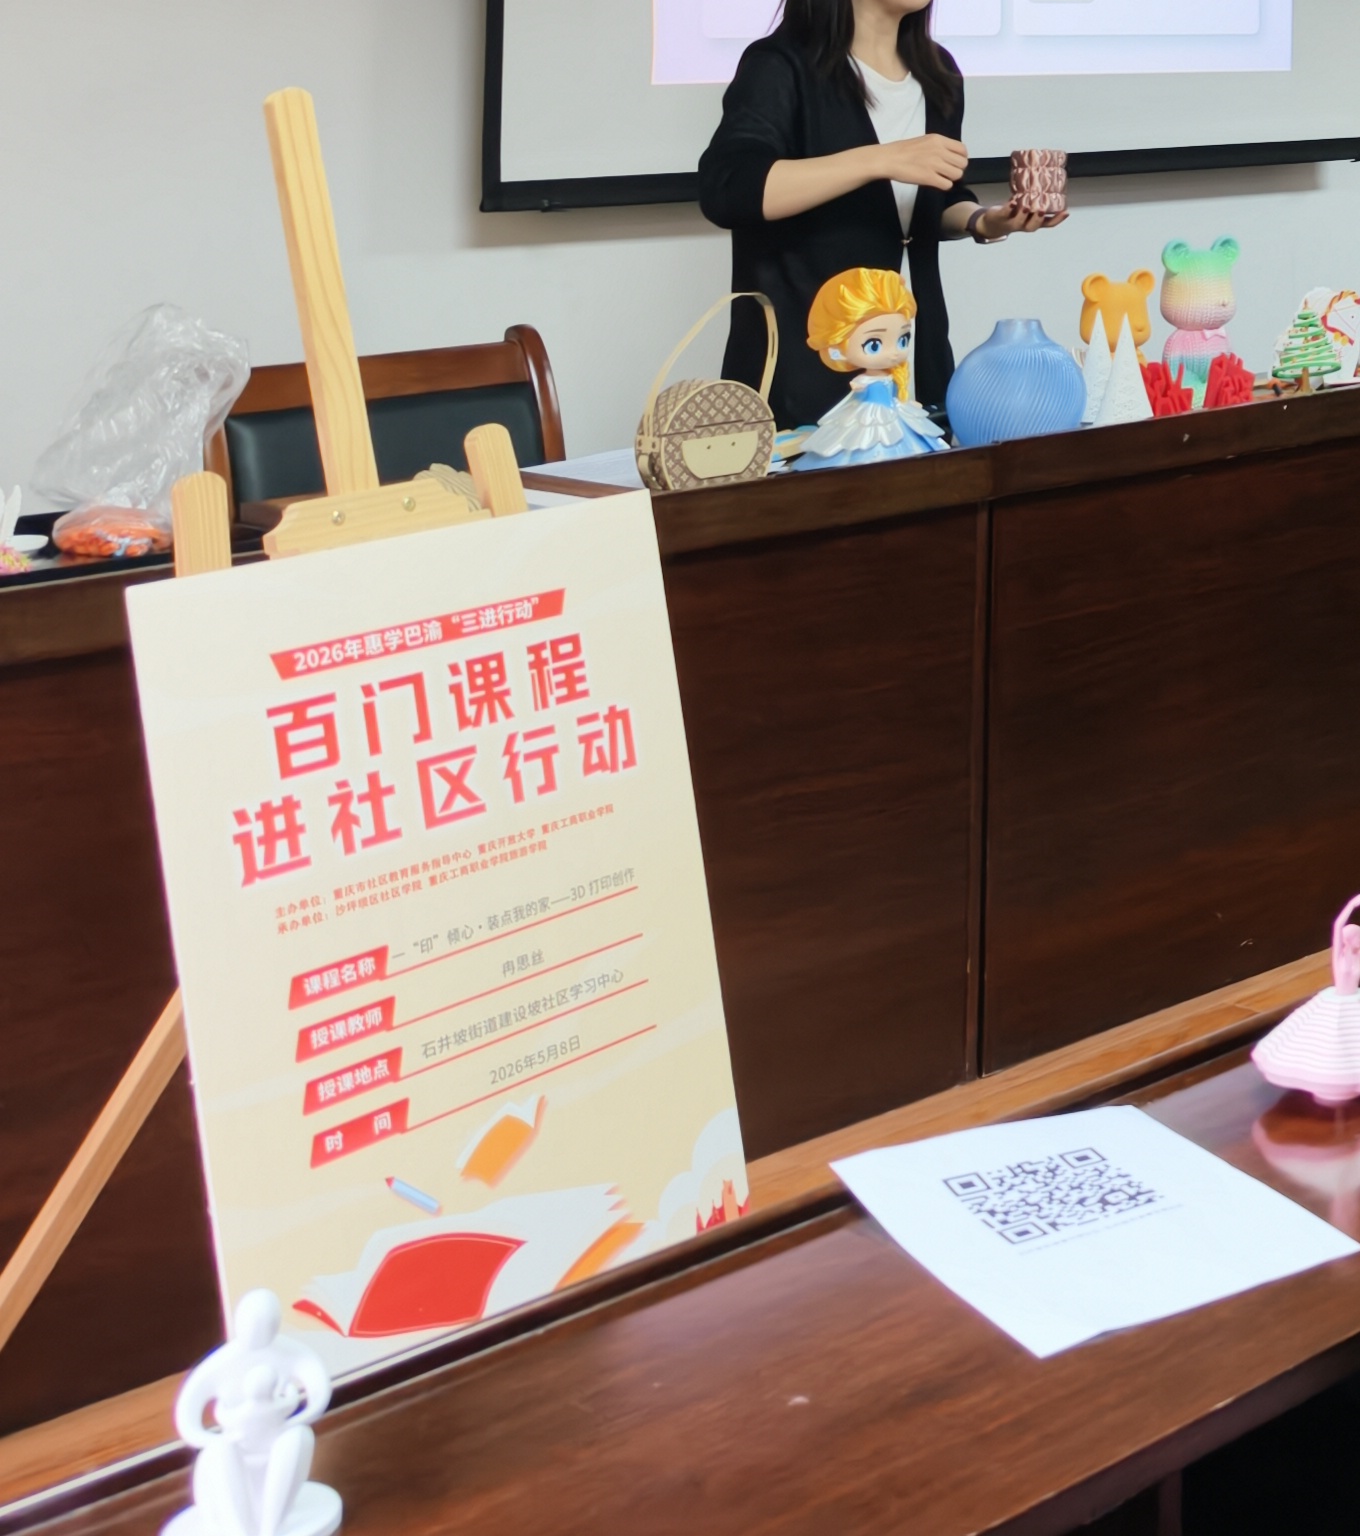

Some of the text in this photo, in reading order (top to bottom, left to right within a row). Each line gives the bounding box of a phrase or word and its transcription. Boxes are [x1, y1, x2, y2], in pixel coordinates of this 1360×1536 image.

[293, 596, 540, 672] 2026年惠学巴渝“三进行动”
[266, 633, 591, 781] 百门课程
[232, 705, 638, 887] 进社区行动
[303, 956, 376, 997] 课程名称
[310, 1007, 383, 1050] 授课教师
[420, 967, 625, 1060] 石井坡街道建设坡社区学习中心
[317, 1058, 391, 1103] 授课地点
[489, 1035, 582, 1086] 2026年5月8日
